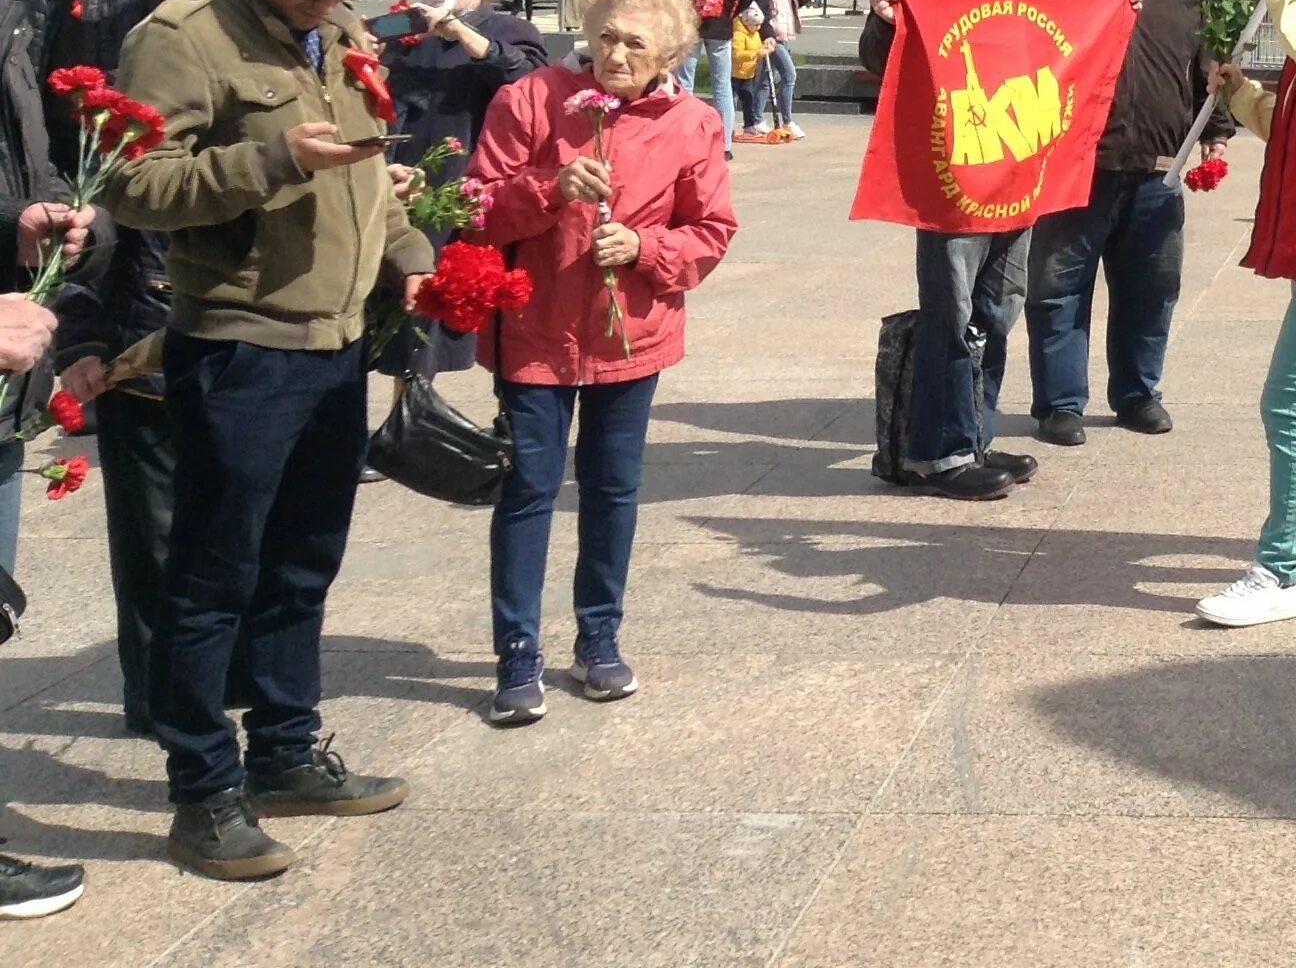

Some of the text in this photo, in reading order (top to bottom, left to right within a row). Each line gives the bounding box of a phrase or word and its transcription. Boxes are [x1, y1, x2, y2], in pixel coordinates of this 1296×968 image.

[937, 0, 1073, 59] ТРУДОВАЯ РОССИЯ
[930, 87, 960, 200] АВАНГАРД
[956, 193, 1031, 219] КРАСНОЙ
[950, 65, 1063, 166] АКМ
